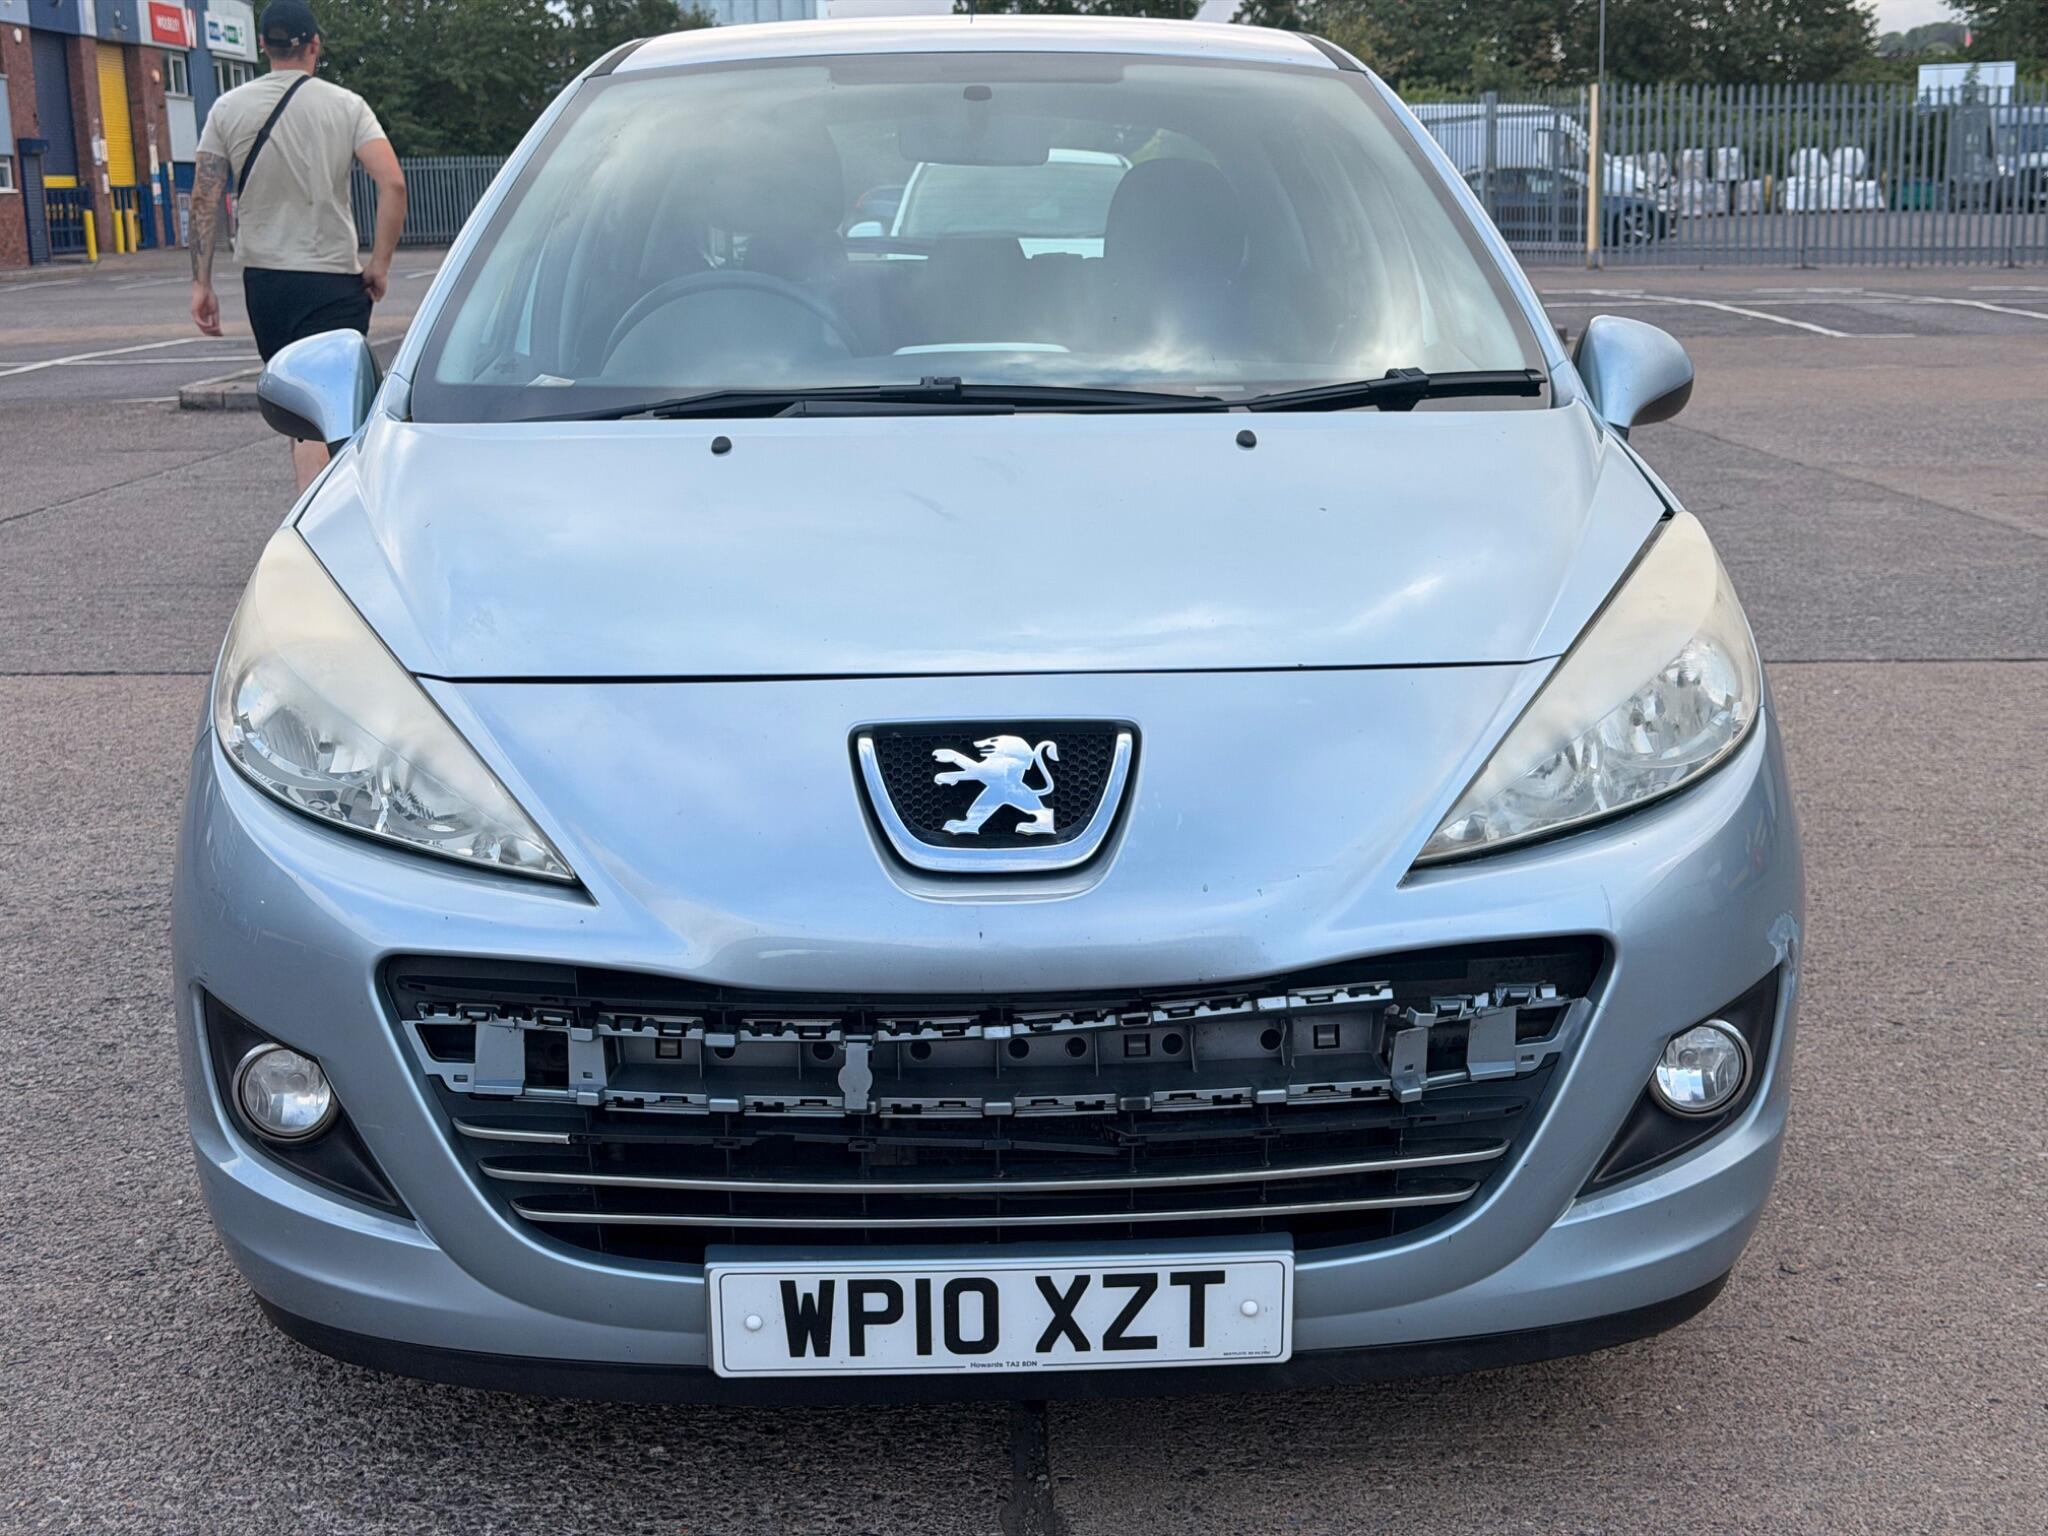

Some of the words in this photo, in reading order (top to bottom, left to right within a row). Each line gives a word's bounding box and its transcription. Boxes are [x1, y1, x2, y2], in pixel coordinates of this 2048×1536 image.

[780, 1277, 1000, 1358] WP10
[1034, 1270, 1226, 1353] XZT
[970, 1361, 1004, 1369] Howards
